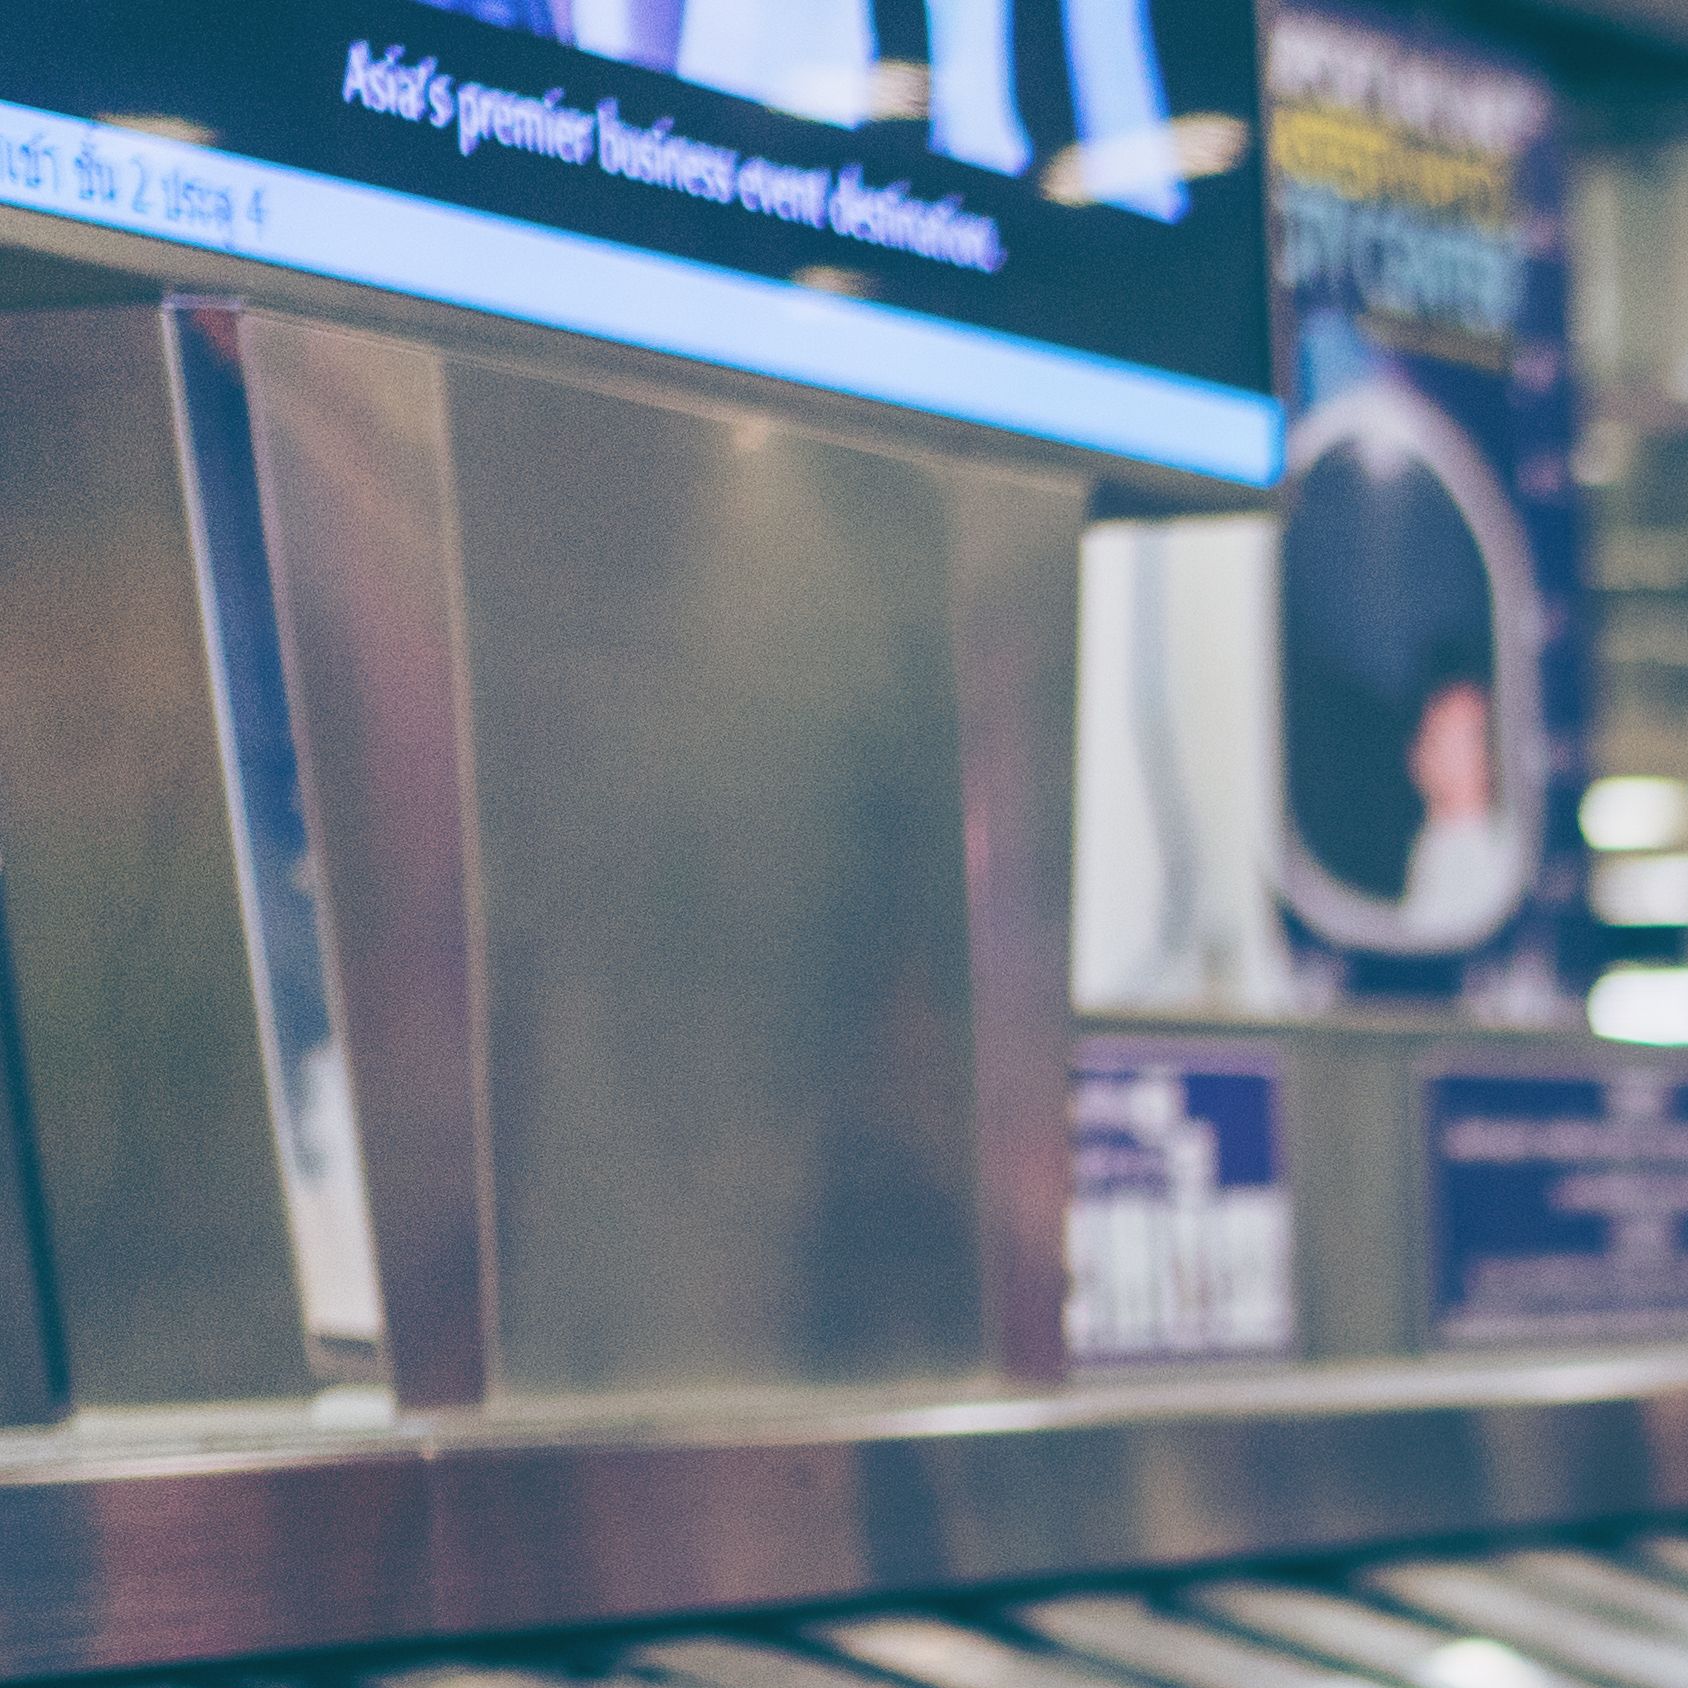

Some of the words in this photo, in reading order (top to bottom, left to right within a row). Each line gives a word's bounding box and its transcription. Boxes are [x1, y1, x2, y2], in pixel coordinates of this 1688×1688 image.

[130, 155, 152, 214] 2
[342, 39, 454, 128] Asia's
[456, 81, 595, 166] premier
[596, 96, 739, 205] business
[738, 156, 833, 230] event
